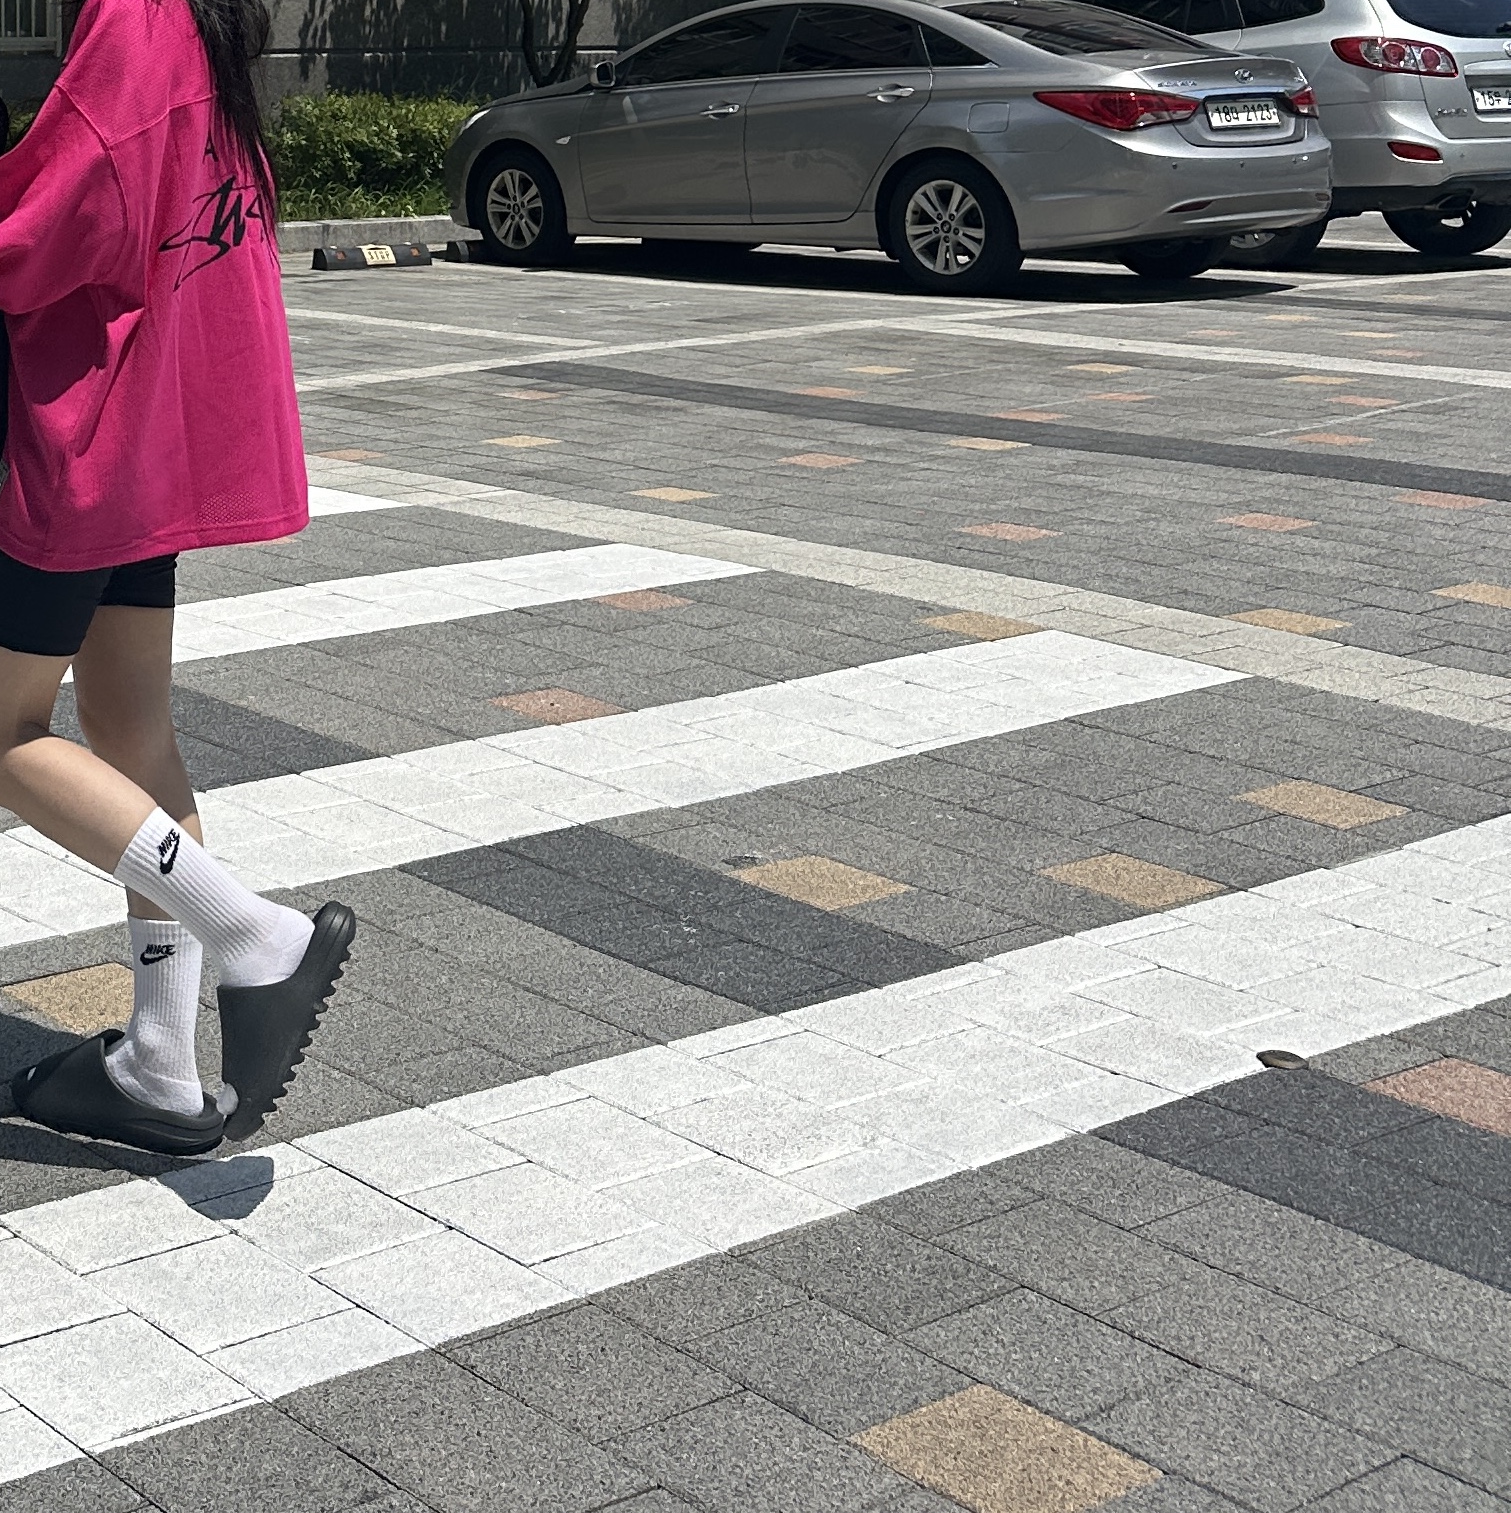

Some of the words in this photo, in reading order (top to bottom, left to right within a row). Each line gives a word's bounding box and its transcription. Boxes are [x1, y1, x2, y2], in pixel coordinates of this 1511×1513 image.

[1243, 103, 1273, 122] 2123
[157, 828, 180, 858] NIKE
[145, 943, 177, 956] NIKE
